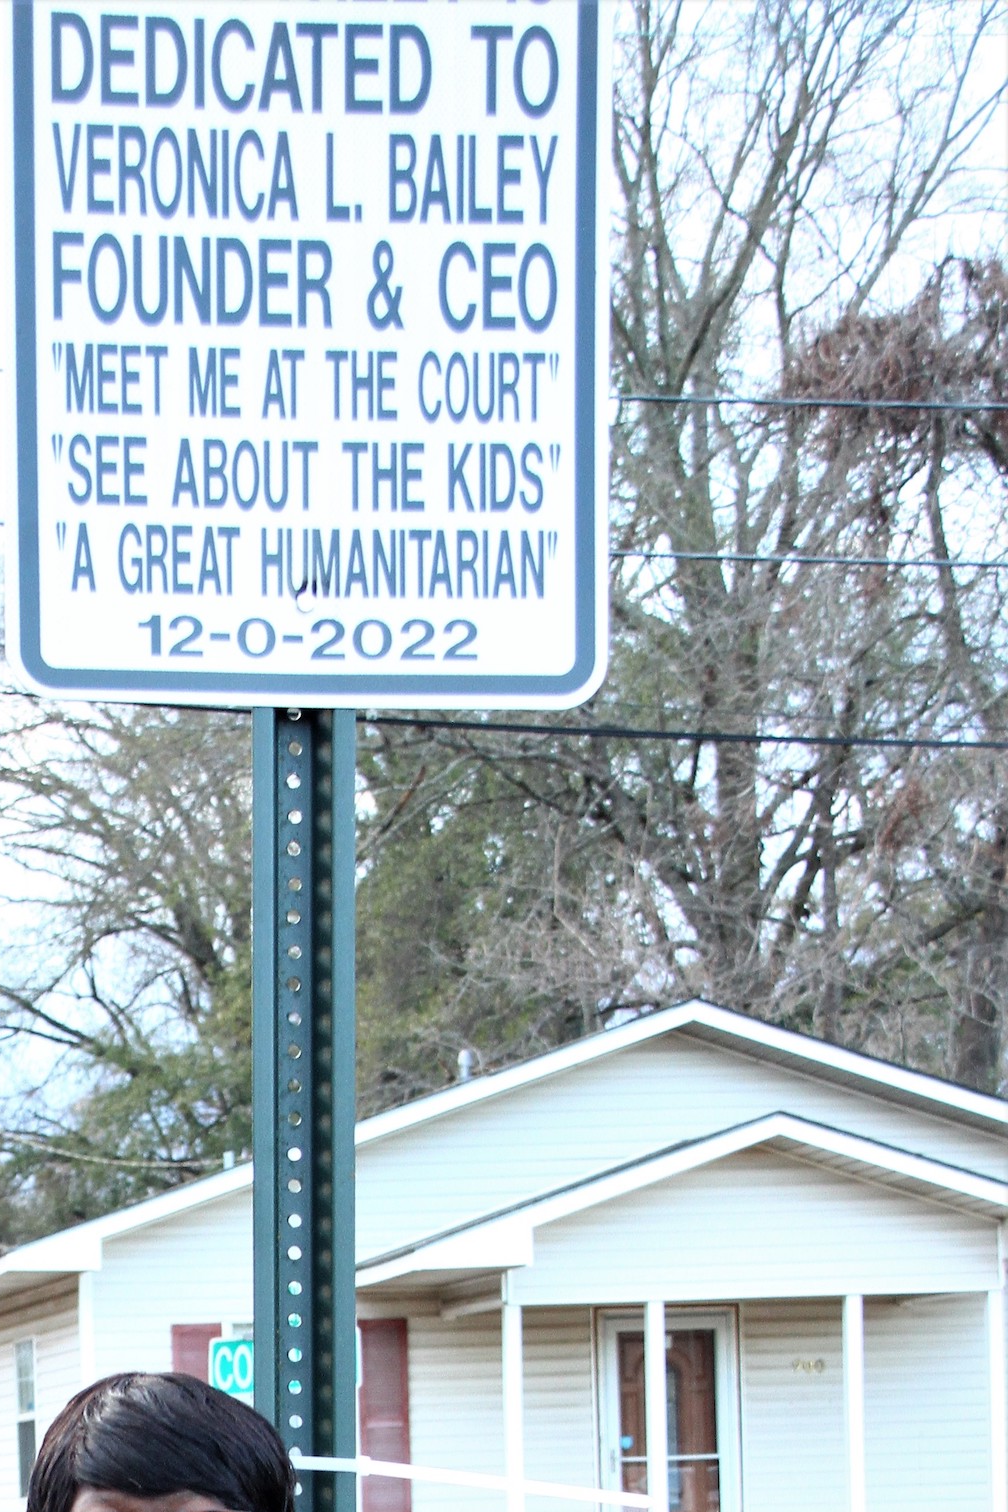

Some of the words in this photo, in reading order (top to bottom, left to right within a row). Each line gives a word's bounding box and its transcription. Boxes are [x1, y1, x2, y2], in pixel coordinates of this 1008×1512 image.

[50, 11, 433, 115] DEDICATED
[471, 24, 560, 119] TO
[52, 122, 299, 222] VERONICA
[326, 132, 363, 223] L.
[389, 133, 559, 224] BAILEY
[52, 231, 333, 328] FOUNDER
[367, 240, 405, 331] &
[439, 241, 558, 333] CEO
[51, 341, 169, 416] "MEET
[189, 346, 242, 418] ME
[261, 349, 306, 420] AT
[325, 350, 398, 421] THE
[418, 350, 560, 424] COURT"
[51, 433, 148, 506] "SEE
[172, 438, 319, 512] ABOUT
[342, 442, 426, 512] THE
[448, 442, 561, 514] KIDS"
[55, 521, 97, 592] "A
[118, 523, 241, 596] GREAT
[261, 527, 558, 602] HUMANITARIAN"
[138, 614, 478, 660] 12-0-2022
